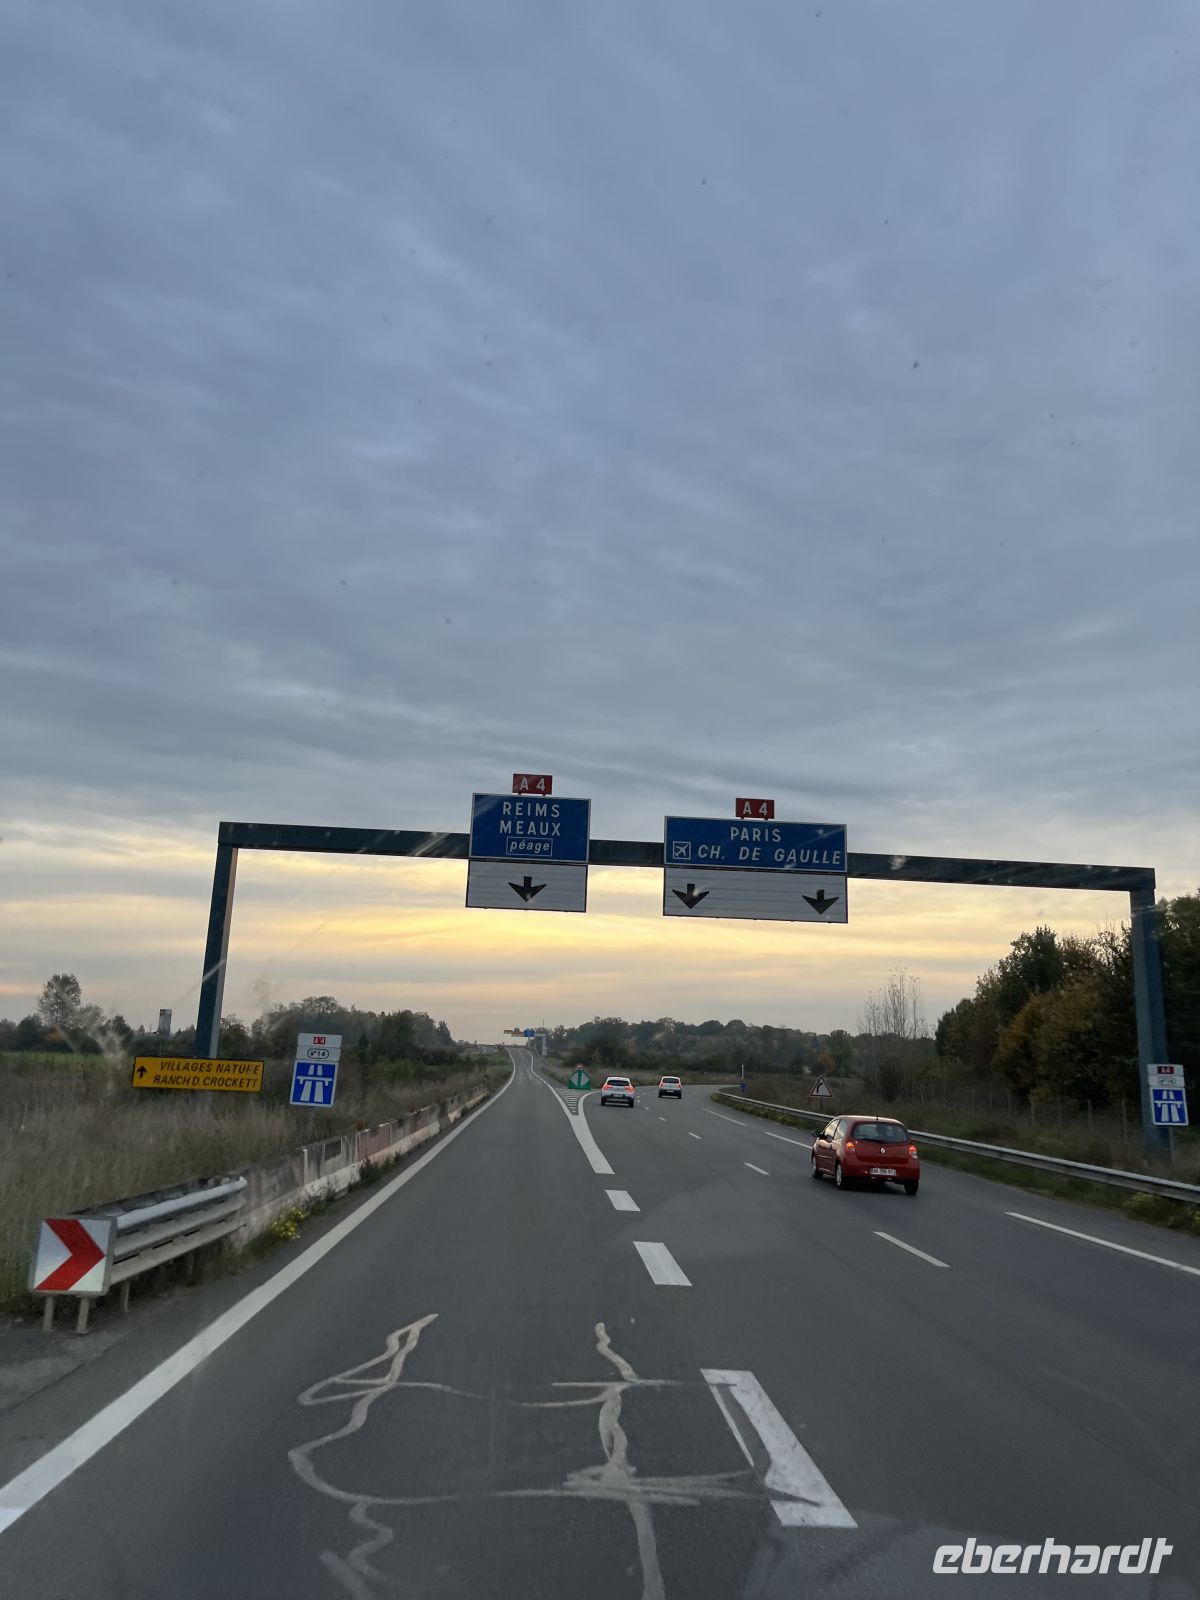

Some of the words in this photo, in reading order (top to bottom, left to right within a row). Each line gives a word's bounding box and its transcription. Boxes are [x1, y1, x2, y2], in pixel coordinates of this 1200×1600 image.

[520, 777, 529, 791] A
[536, 778, 546, 791] 4
[502, 801, 560, 818] REIMS
[742, 801, 752, 815] A
[758, 802, 768, 816] 4
[499, 819, 561, 837] MEAUX
[730, 826, 782, 843] PARIS
[509, 839, 550, 854] péage
[697, 844, 725, 860] CH.
[738, 847, 763, 861] DE
[774, 848, 841, 865] GAULLE
[160, 1061, 213, 1073] VILLAGES
[216, 1063, 260, 1076] NATURE
[153, 1074, 191, 1086] RANCH
[203, 1077, 259, 1088] CROCKETT
